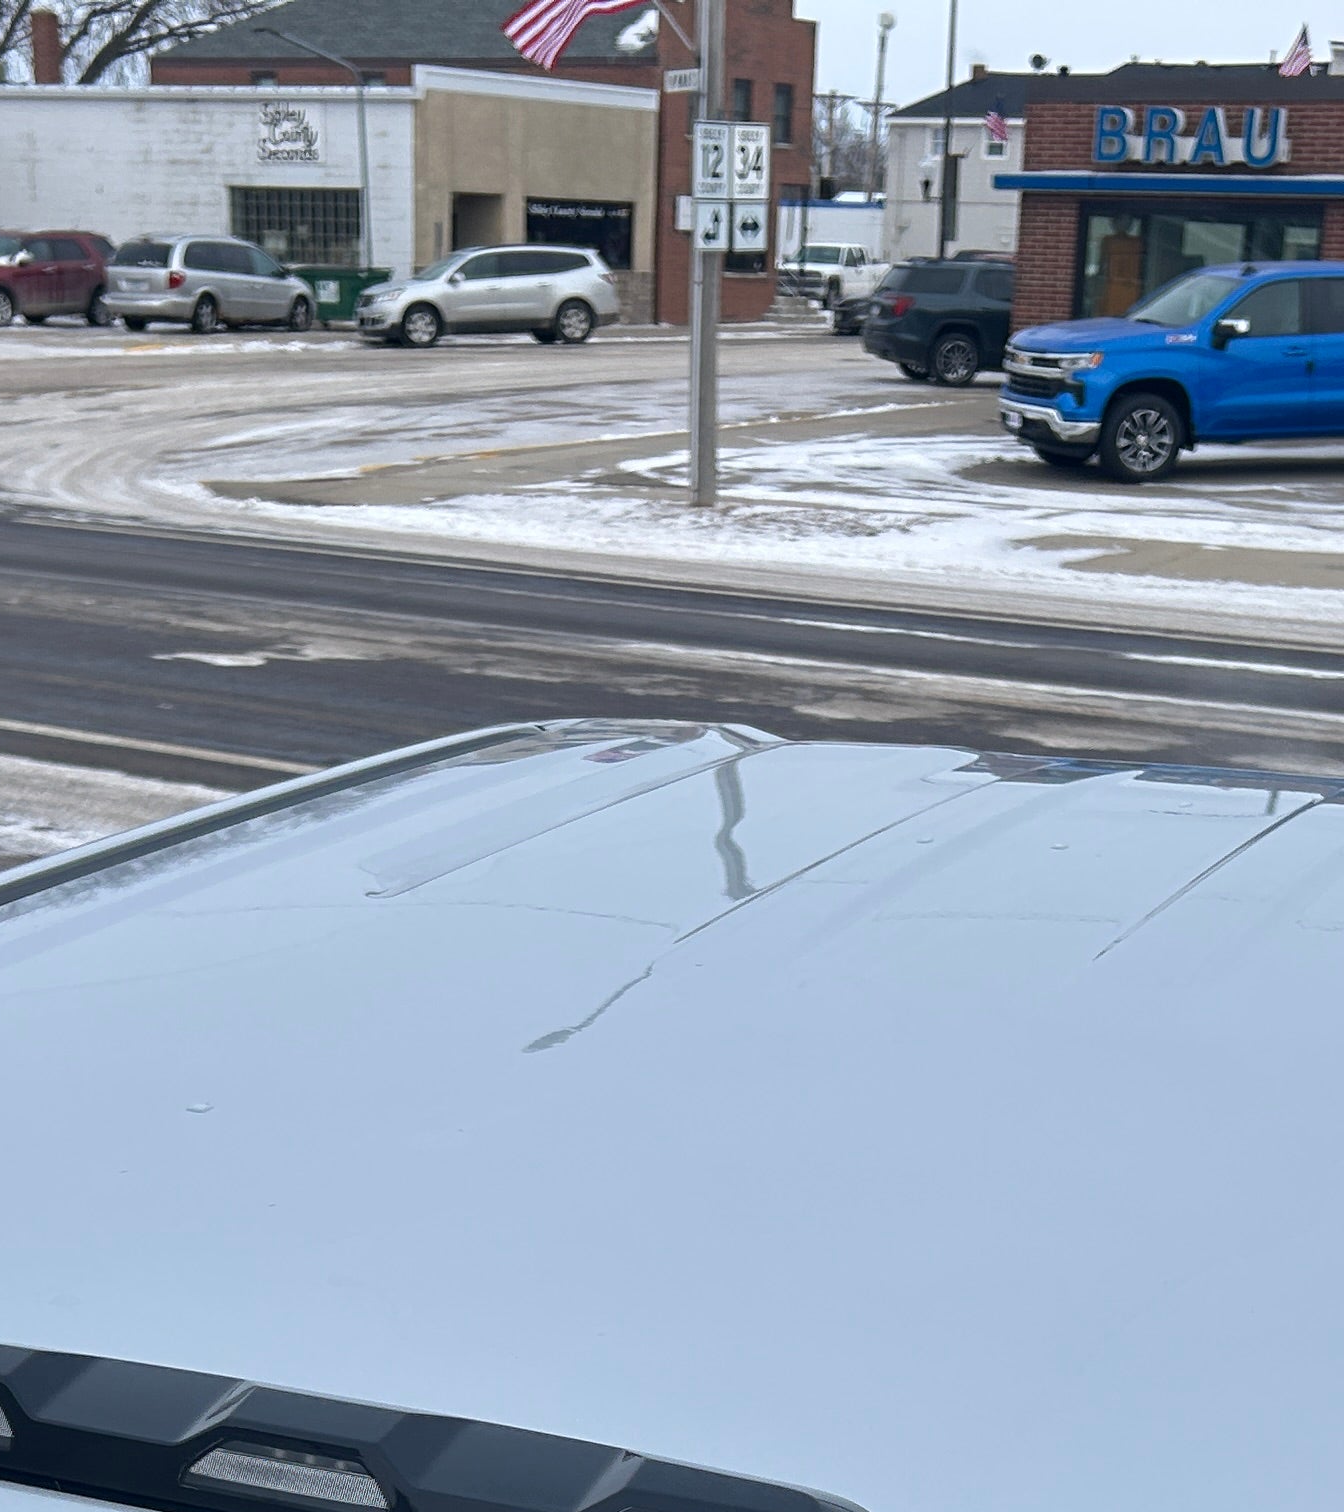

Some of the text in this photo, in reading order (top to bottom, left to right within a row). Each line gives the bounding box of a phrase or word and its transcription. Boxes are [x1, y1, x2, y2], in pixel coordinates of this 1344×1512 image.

[1090, 104, 1291, 168] BRAU
[701, 144, 725, 178] 12
[736, 145, 764, 180] 34
